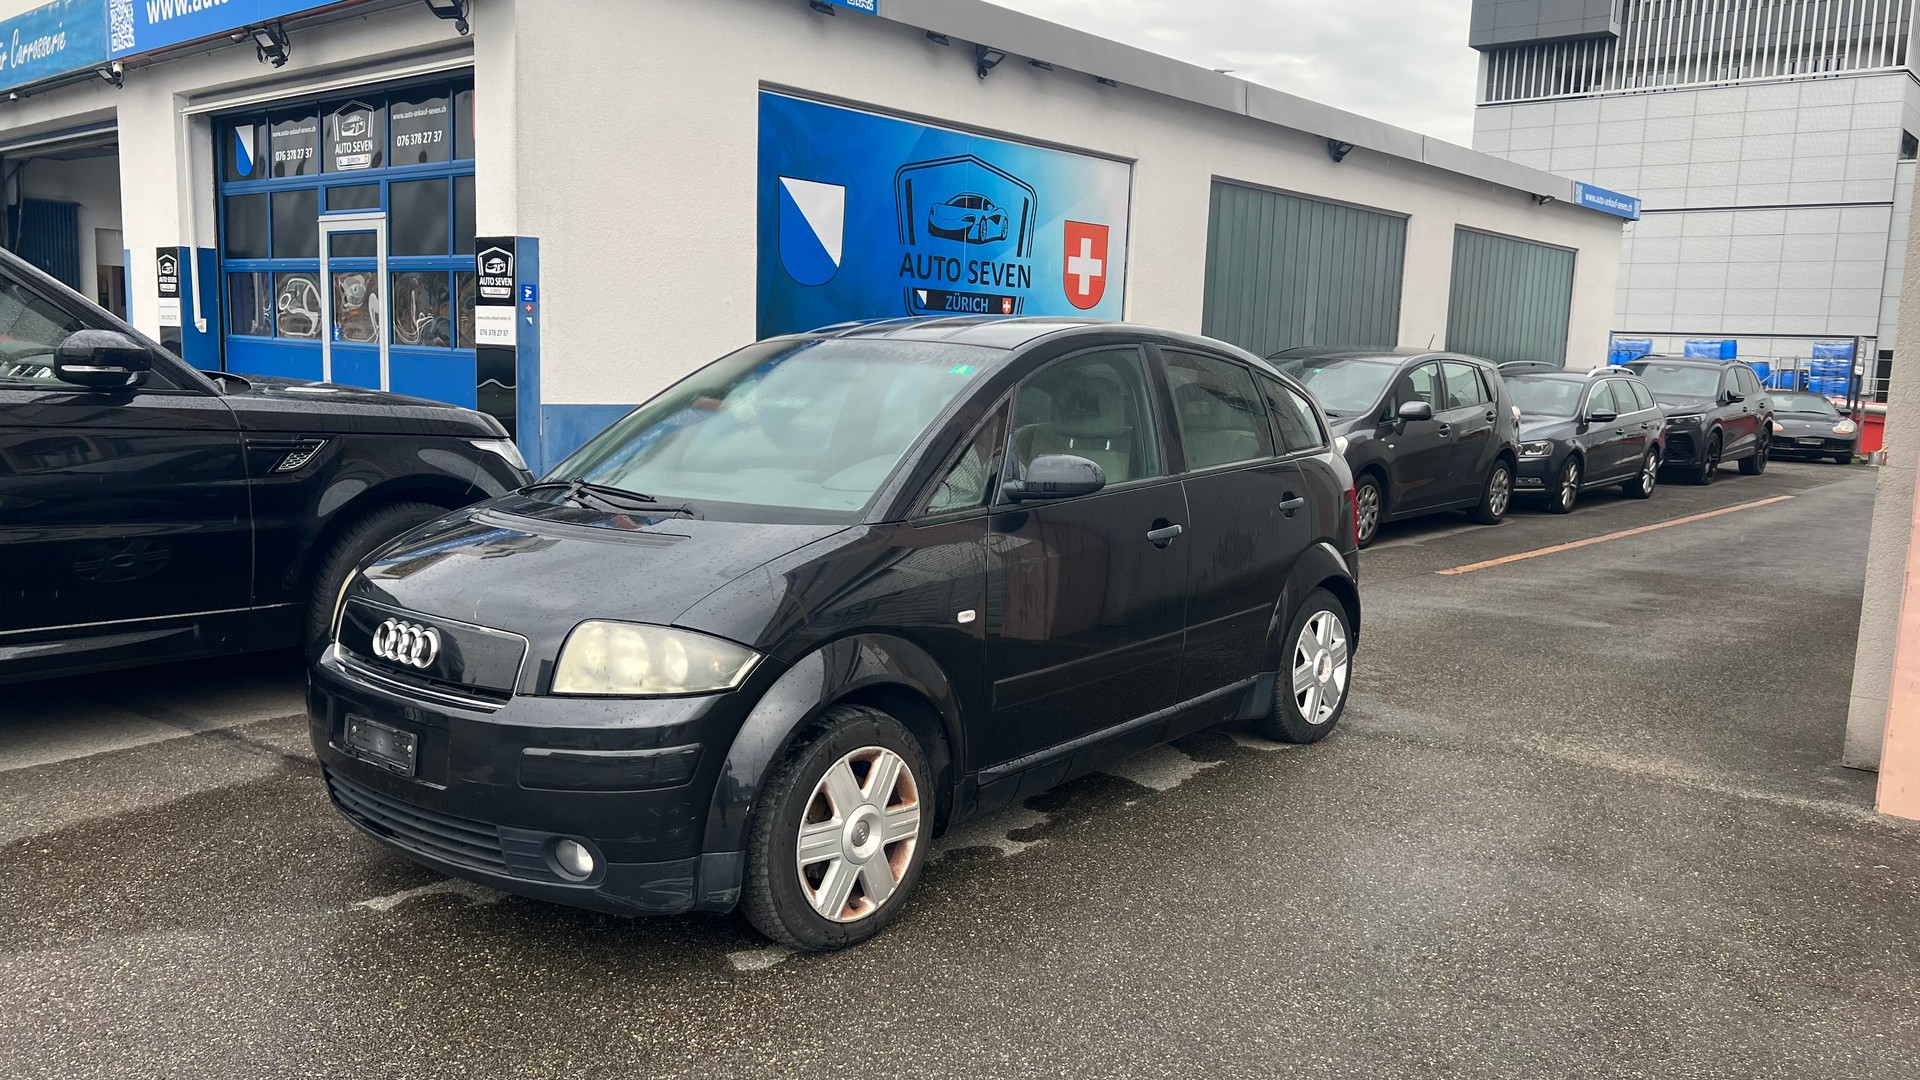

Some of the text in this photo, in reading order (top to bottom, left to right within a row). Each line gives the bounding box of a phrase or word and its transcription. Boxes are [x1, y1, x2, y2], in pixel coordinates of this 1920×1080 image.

[11, 21, 67, 69] Carrosserie
[392, 105, 447, 120] www.auto-ankauf-seven.ch
[396, 130, 443, 147] 076 378 27 37
[275, 147, 313, 161] 076 378 27 37
[335, 139, 373, 155] AUTO SEVEN
[900, 252, 1031, 289] AUTO SEVEN
[479, 276, 513, 287] AUTO SEVEN
[945, 293, 989, 313] ZÜRICH
